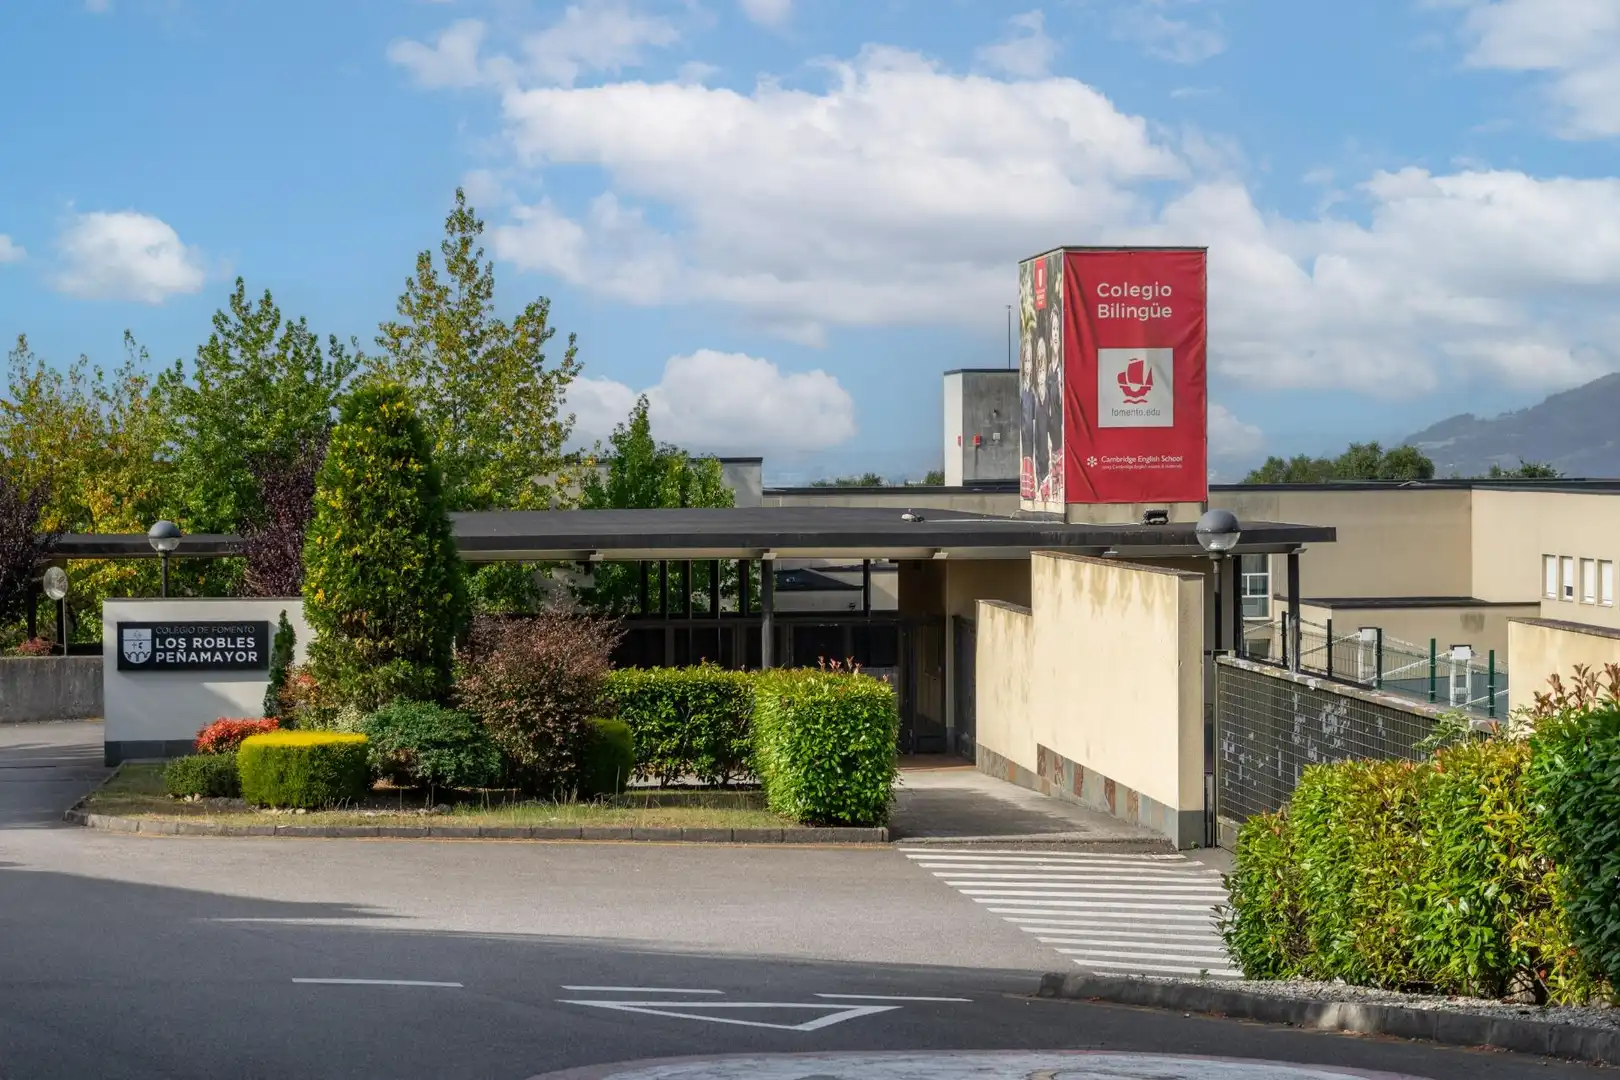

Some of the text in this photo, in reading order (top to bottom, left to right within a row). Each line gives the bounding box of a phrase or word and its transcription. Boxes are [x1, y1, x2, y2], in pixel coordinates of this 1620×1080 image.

[1097, 281, 1171, 300] Colegio
[1098, 302, 1172, 321] Bilingüe
[1111, 407, 1160, 417] fomento.edu
[1101, 455, 1183, 464] Cambridge English School
[155, 624, 255, 635] COLEGIO DE FOMENTO
[155, 637, 255, 649] LOS ROBLES
[155, 649, 258, 663] PEÑAMAYOR
